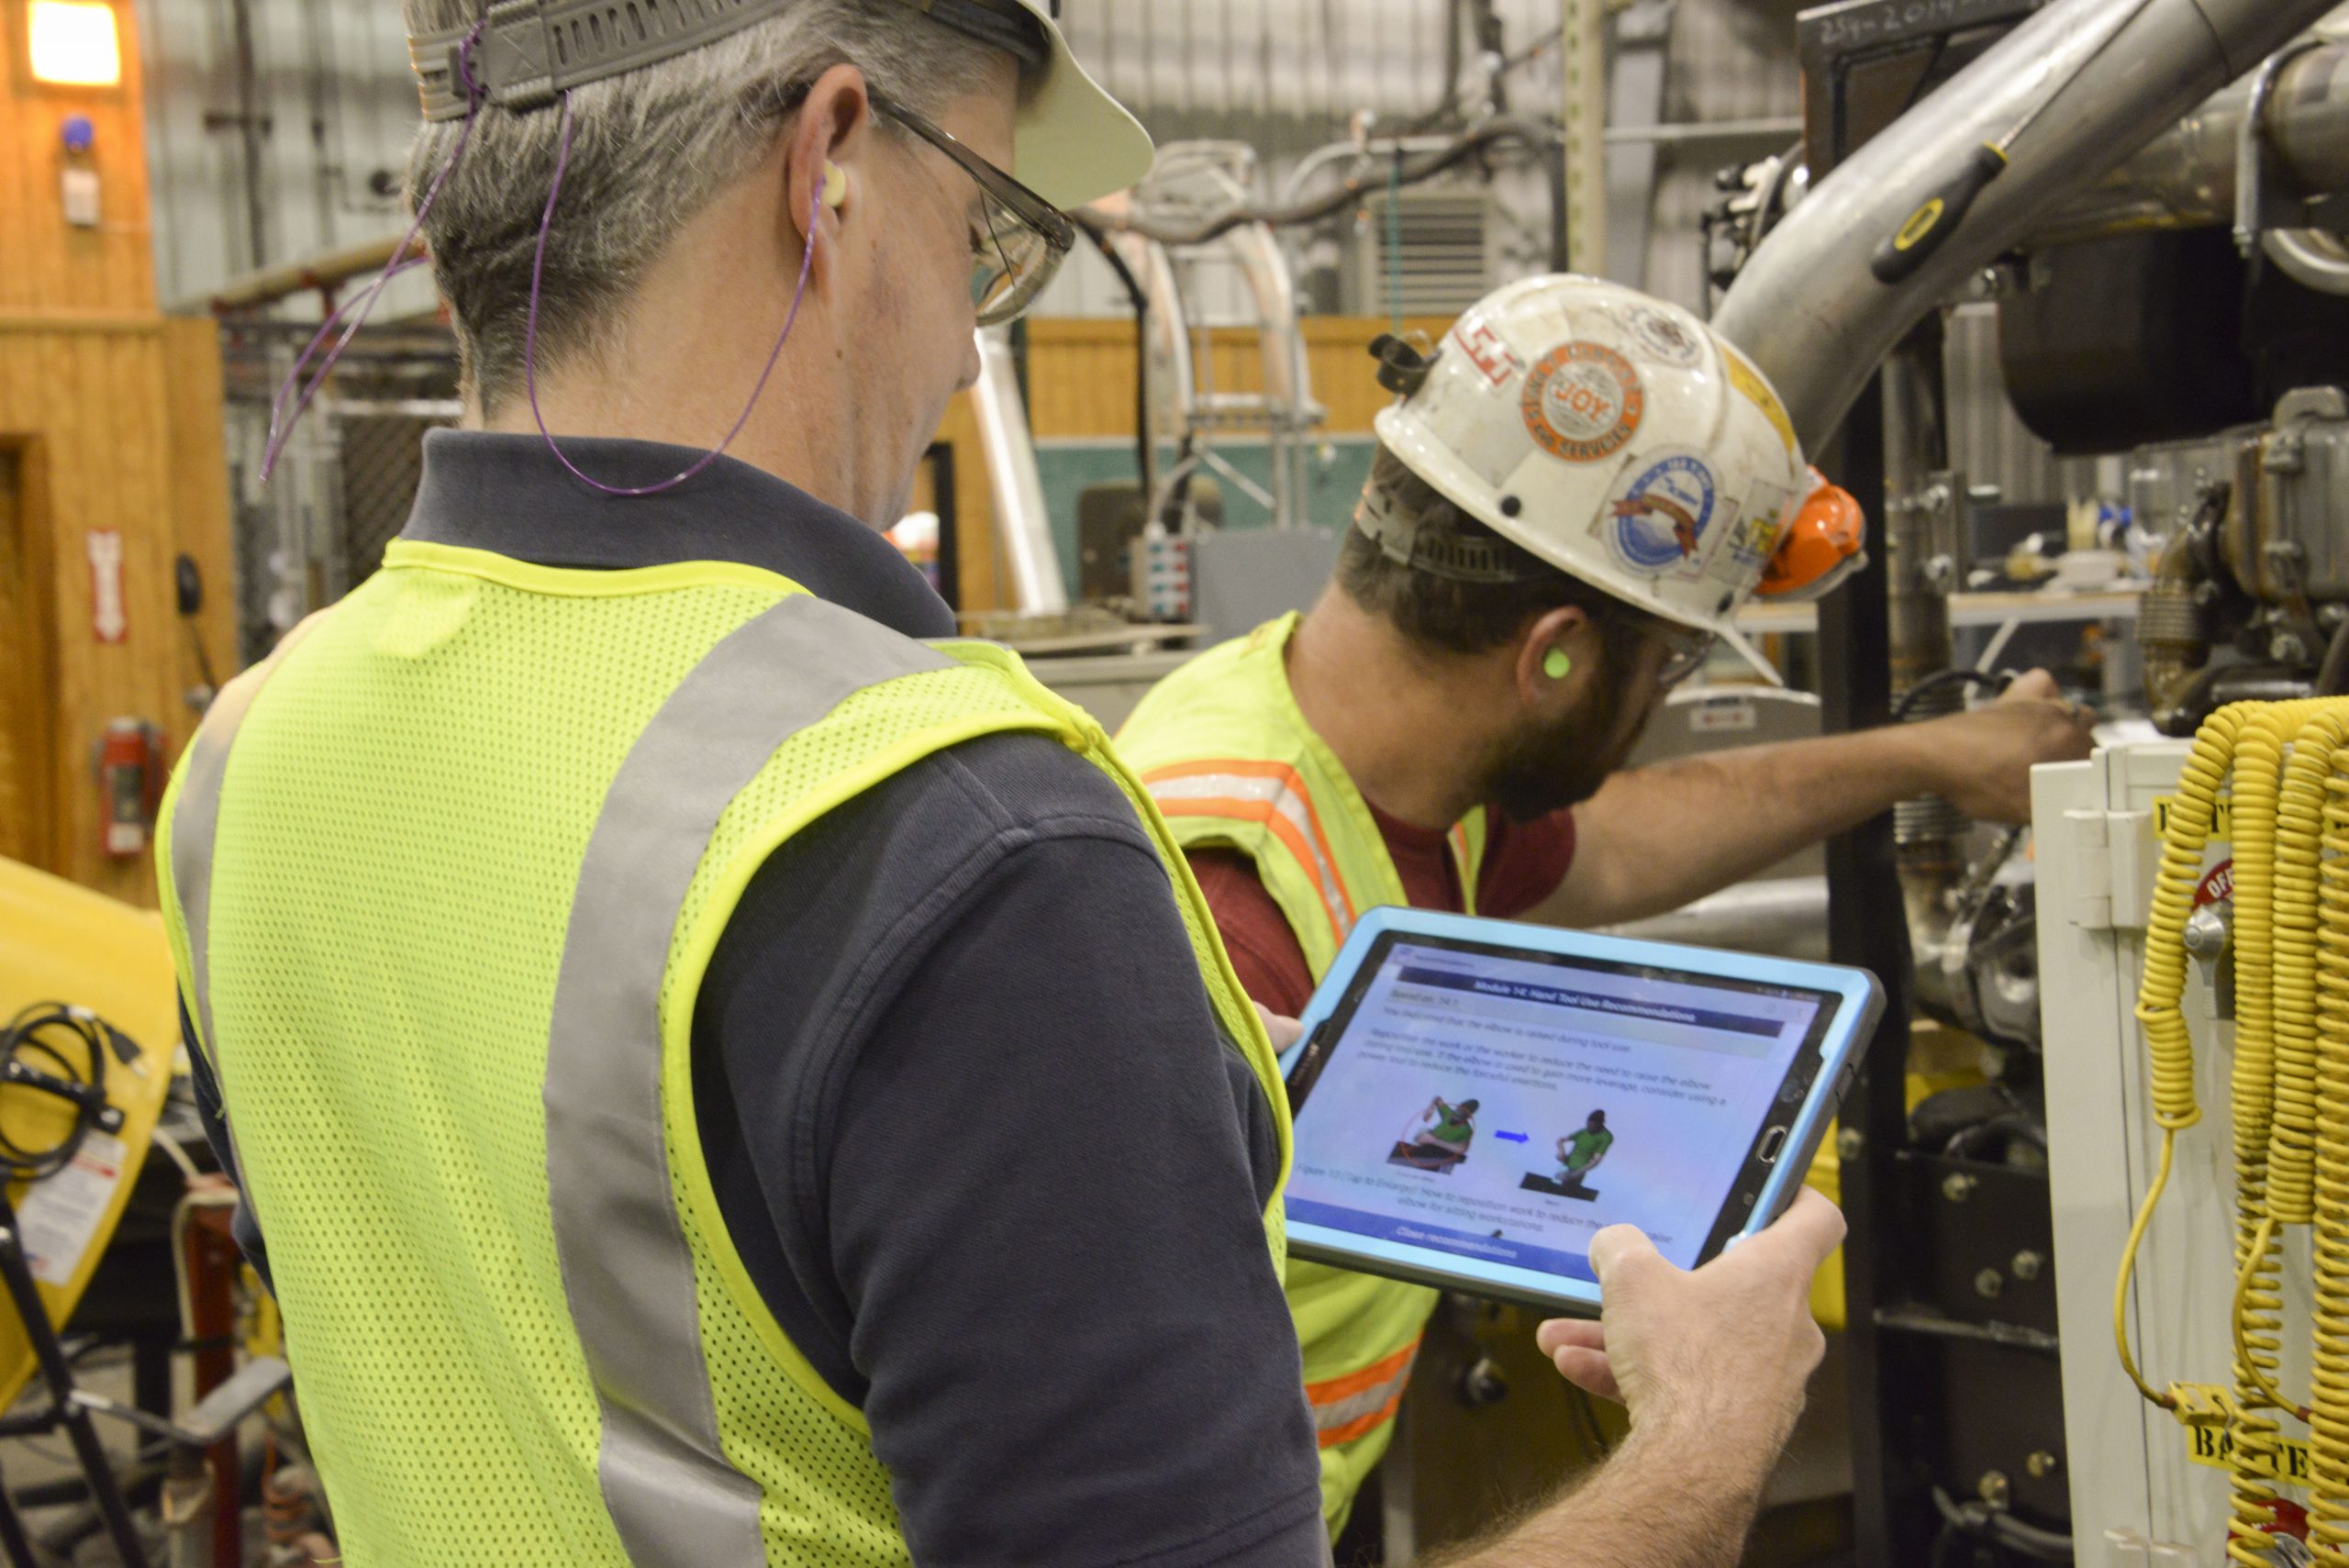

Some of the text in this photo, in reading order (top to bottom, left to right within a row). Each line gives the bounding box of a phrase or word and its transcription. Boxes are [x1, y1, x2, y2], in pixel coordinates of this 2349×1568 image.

[1554, 382, 1611, 423] JOY
[1475, 981, 1511, 994] Module
[1601, 999, 1696, 1022] Recommendations
[1525, 1029, 1555, 1040] raised
[1556, 1034, 1589, 1047] during
[1420, 1061, 1453, 1072] reduce
[1494, 1048, 1526, 1059] worker
[1540, 1055, 1574, 1066] reduce
[1679, 1078, 1711, 1089] elbow
[1464, 1056, 1492, 1066] elbow
[1688, 1092, 1718, 1105] using
[1397, 1195, 1428, 1207] elbow
[1548, 1210, 1585, 1224] reduce
[1424, 1231, 1519, 1258] recommendations
